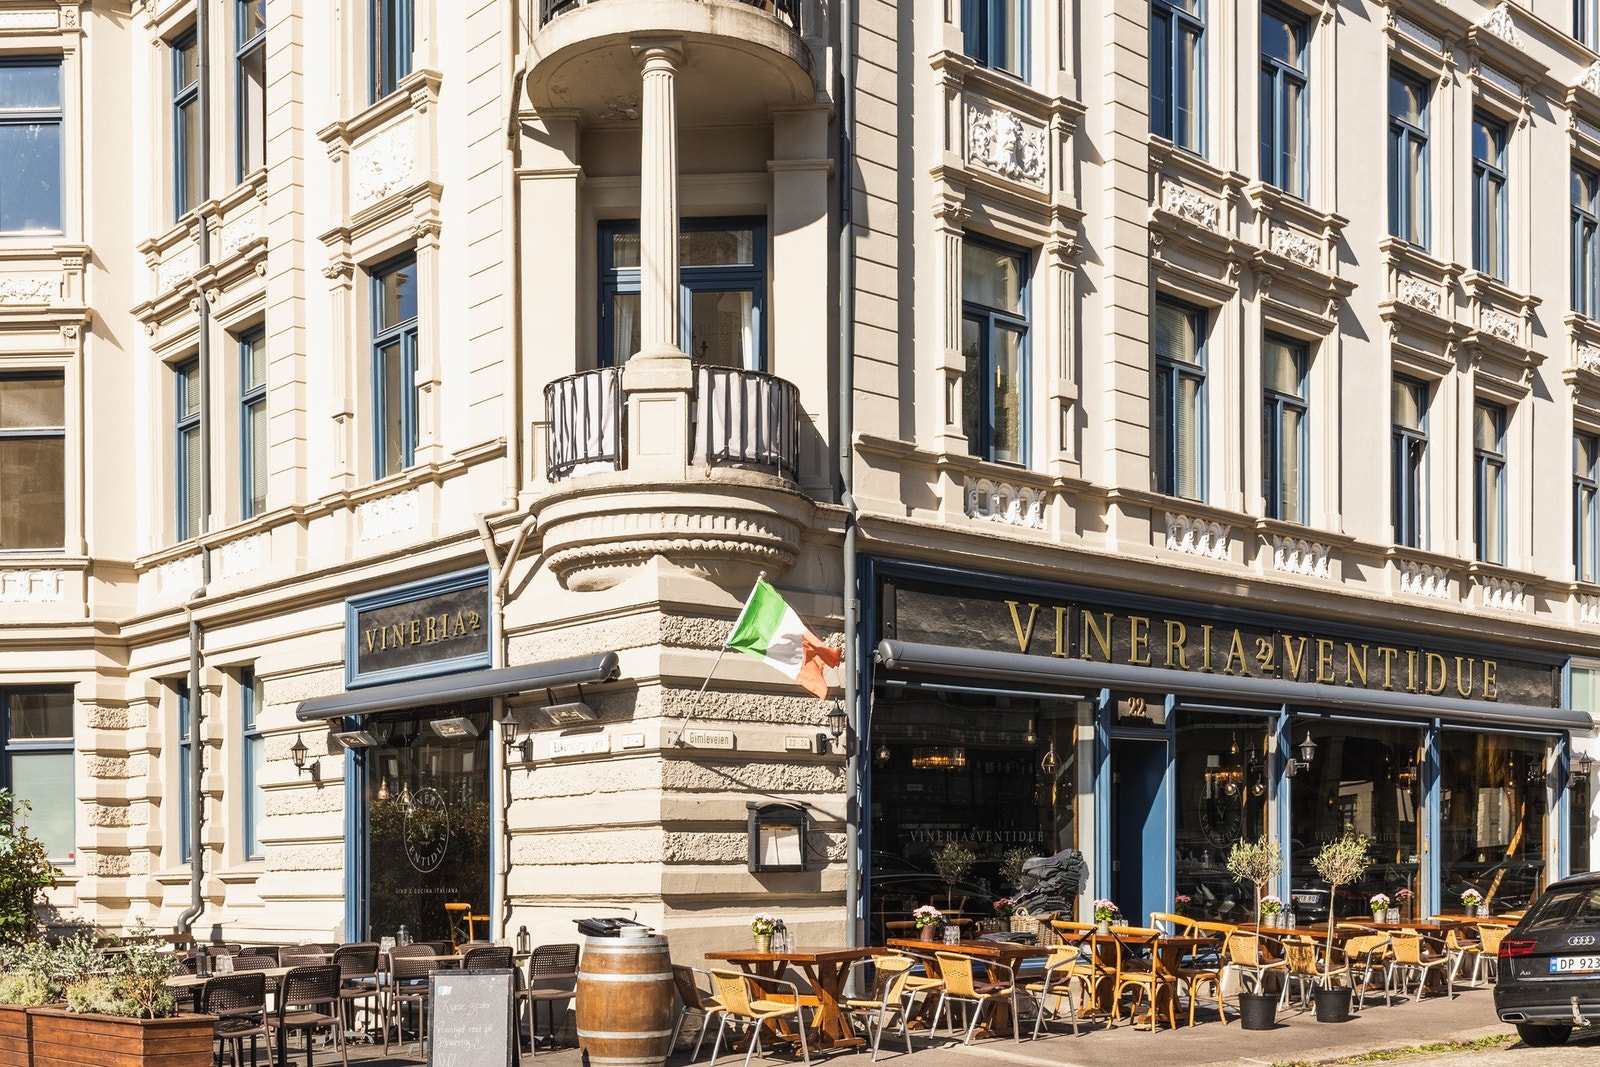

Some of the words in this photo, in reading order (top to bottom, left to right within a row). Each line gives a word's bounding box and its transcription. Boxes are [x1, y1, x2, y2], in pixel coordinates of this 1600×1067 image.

[365, 611, 466, 652] VINERIA
[1005, 600, 1249, 675] VINERIA
[1282, 635, 1498, 698] VENTIDUE
[1127, 697, 1146, 716] 22
[689, 732, 729, 745] Gimleveien
[910, 831, 968, 842] VINERIA
[976, 831, 1044, 842] VENTIDUE
[1560, 958, 1575, 970] DP
[1579, 957, 1600, 969] 923
